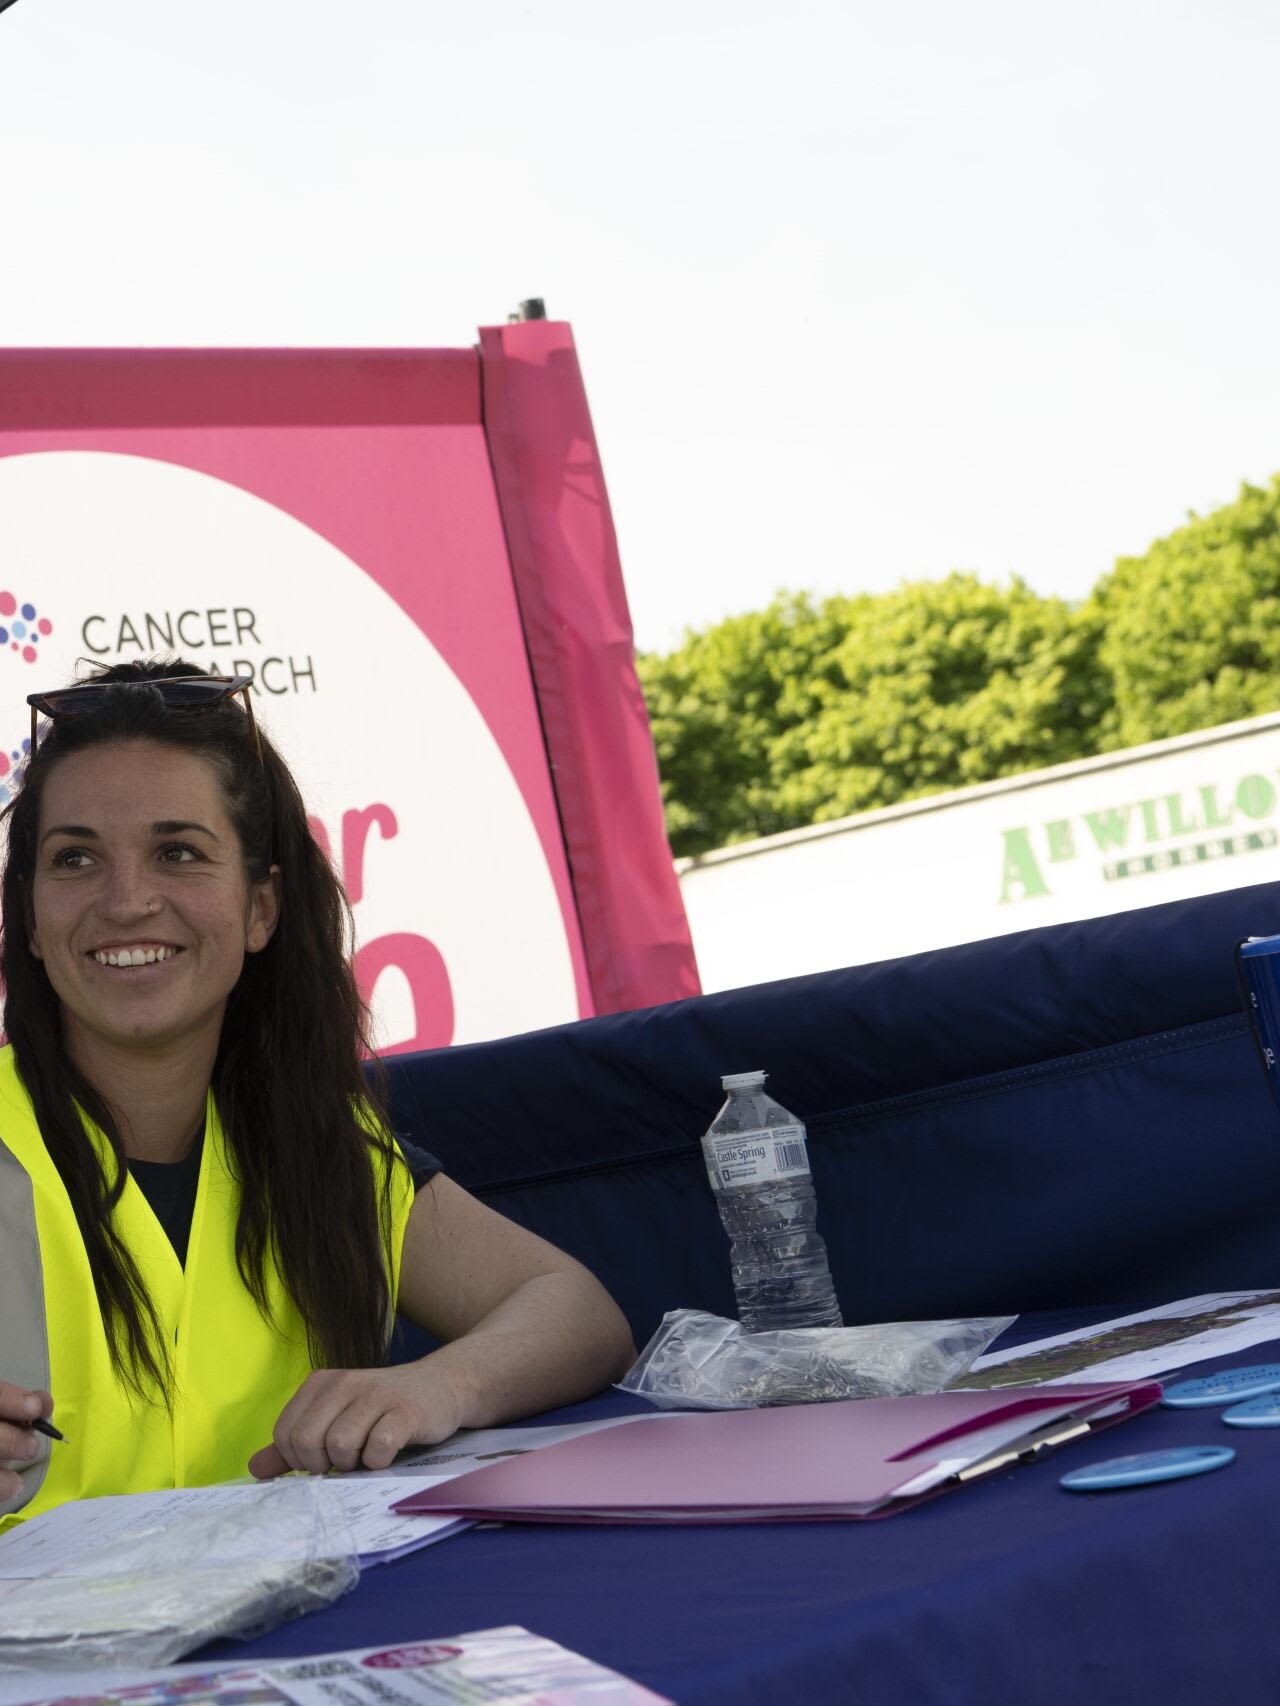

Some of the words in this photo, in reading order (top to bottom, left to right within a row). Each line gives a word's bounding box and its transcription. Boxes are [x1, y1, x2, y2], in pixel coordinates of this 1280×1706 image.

[81, 607, 261, 654] CANCER
[1082, 768, 1280, 852] WILLO
[717, 1149, 738, 1163] Castle
[738, 1146, 766, 1161] Spring
